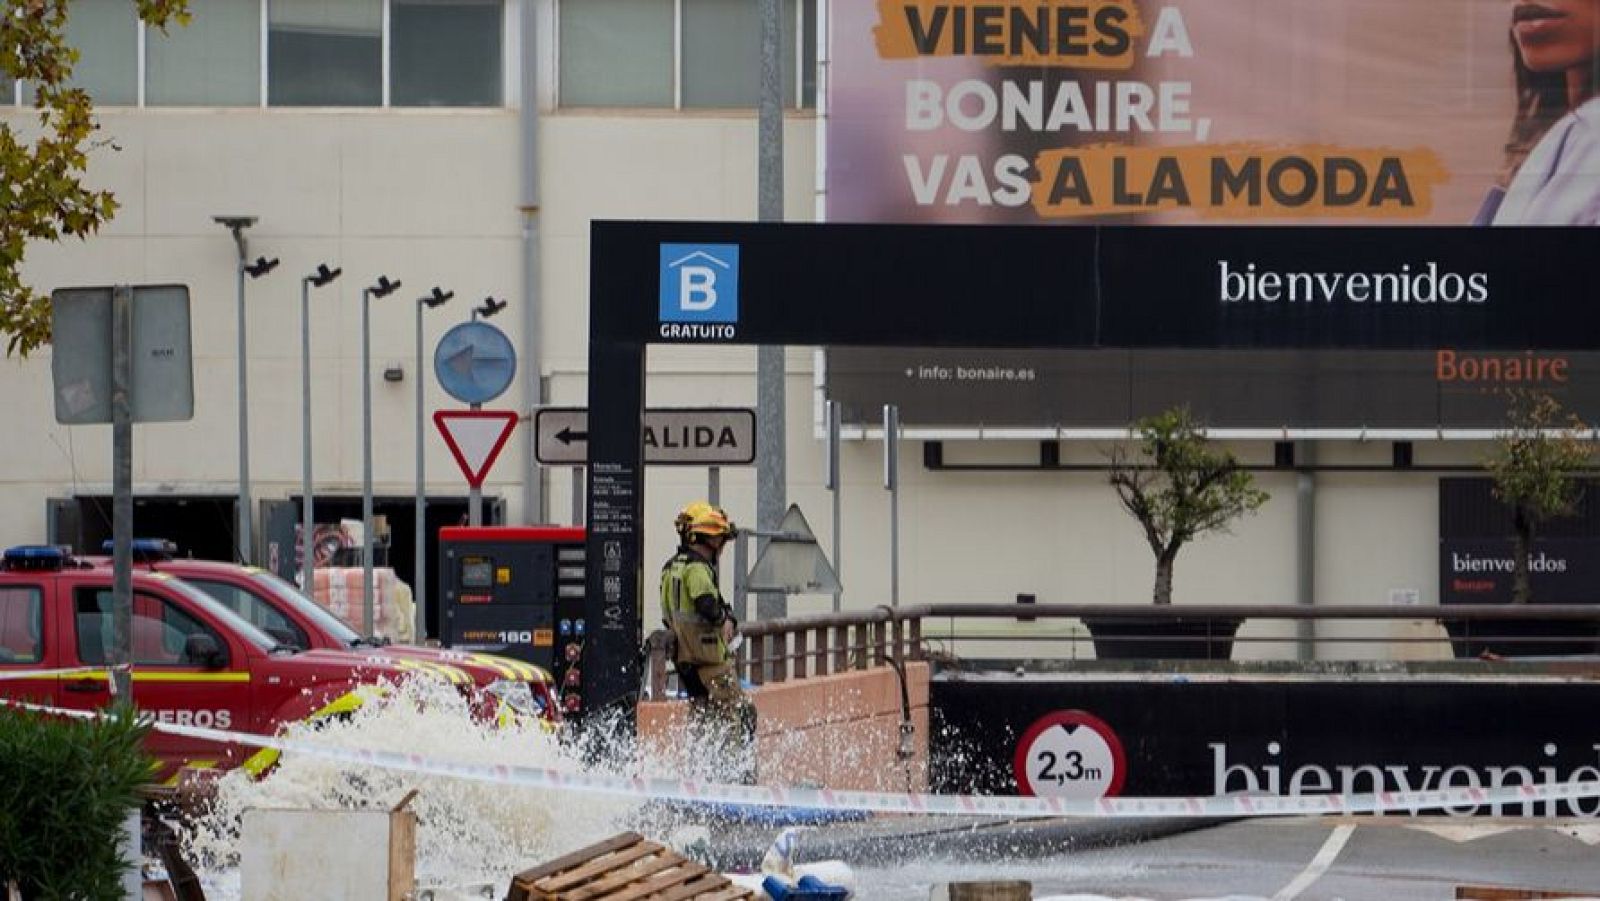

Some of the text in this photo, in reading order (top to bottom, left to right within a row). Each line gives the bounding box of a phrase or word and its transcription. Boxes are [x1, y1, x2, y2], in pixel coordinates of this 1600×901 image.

[904, 5, 1194, 57] VIENES A
[905, 79, 1211, 142] BONAIRE,
[903, 154, 1415, 207] VAS A LA MODA
[681, 265, 717, 311] B
[1218, 260, 1488, 302] bienvenidos
[660, 323, 735, 339] GRATUITO
[919, 365, 953, 379] info:
[957, 365, 1036, 381] bonaire.es
[1436, 350, 1569, 381] Bonaire
[644, 425, 737, 448] ALIDA
[1453, 551, 1567, 572] bienveidos
